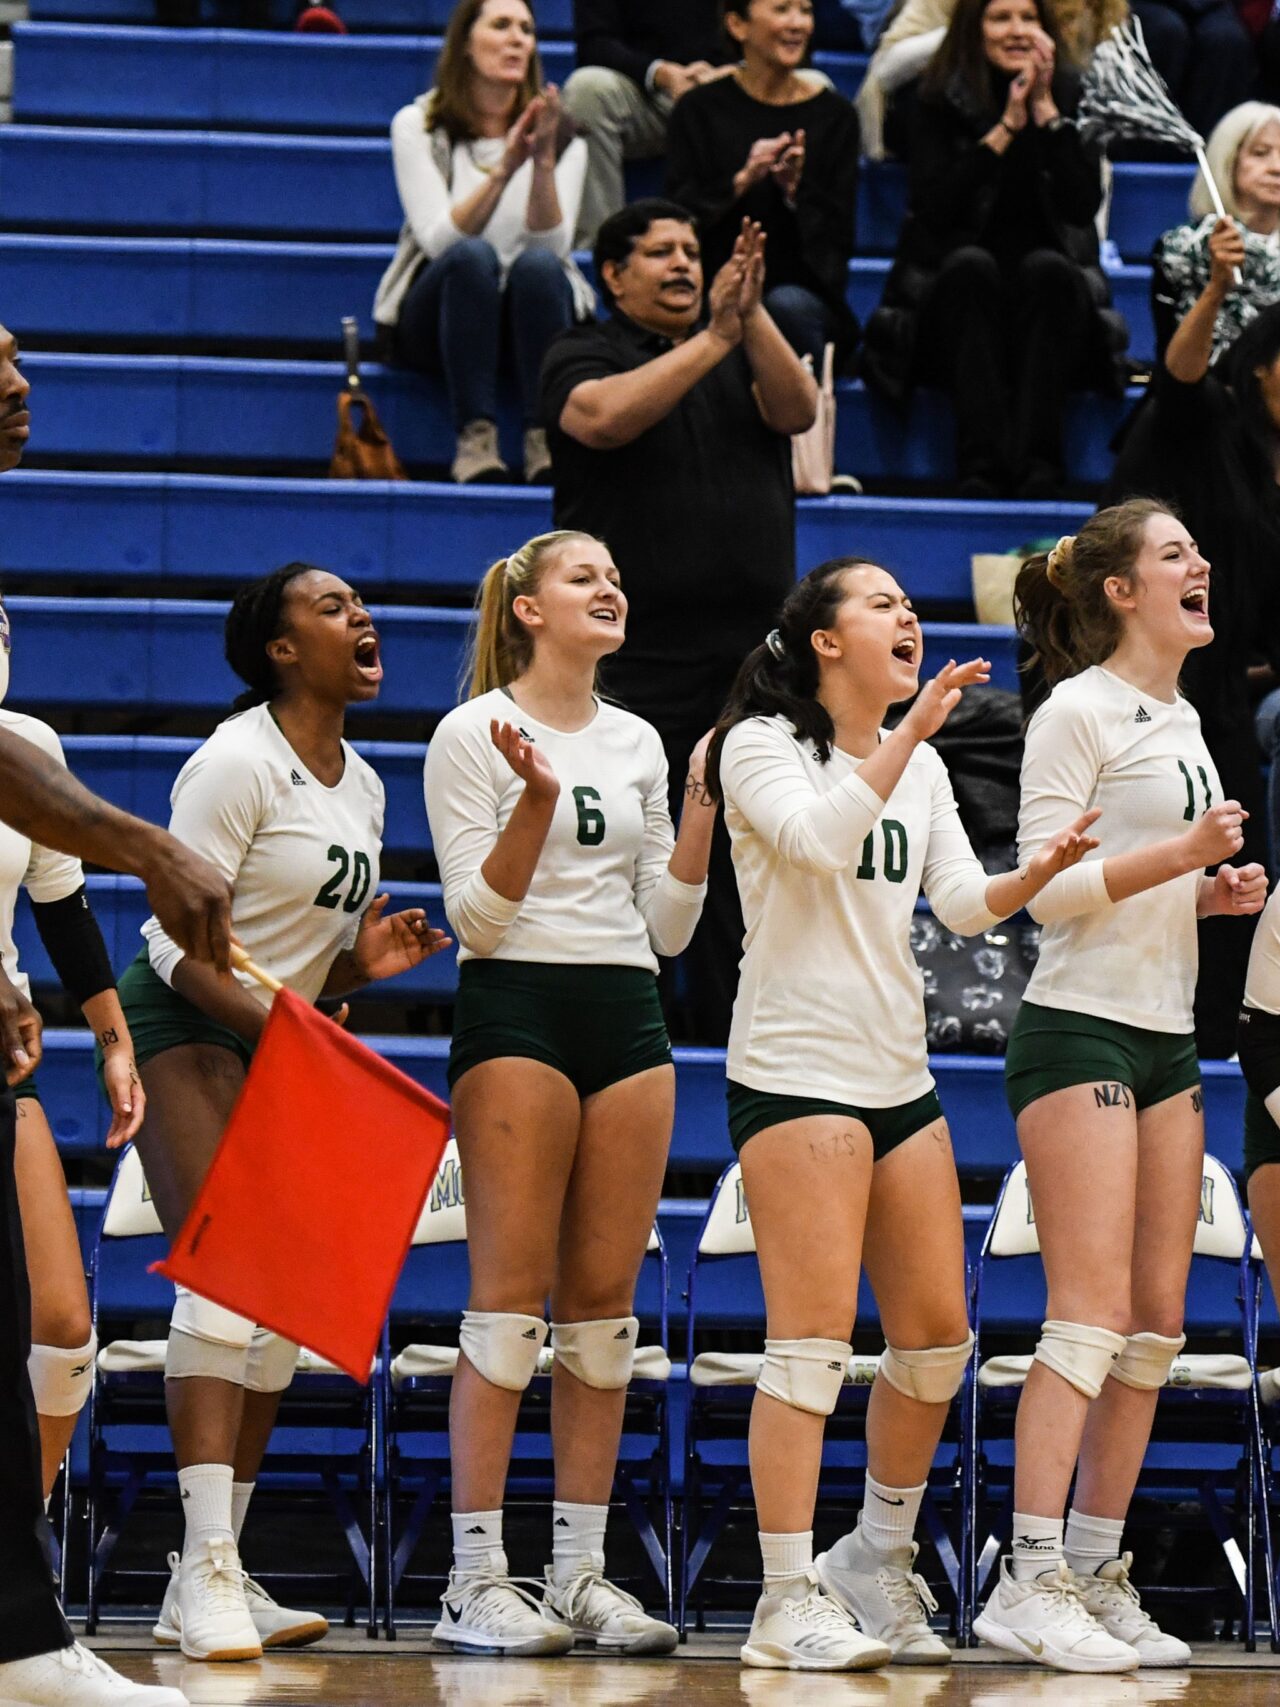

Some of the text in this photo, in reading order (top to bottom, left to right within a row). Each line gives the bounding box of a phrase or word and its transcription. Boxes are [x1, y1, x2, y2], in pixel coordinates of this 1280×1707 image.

[572, 786, 606, 846] 6
[1178, 760, 1212, 821] 11
[313, 844, 371, 913] 20
[855, 819, 908, 883] 10
[1094, 1083, 1130, 1109] NZS
